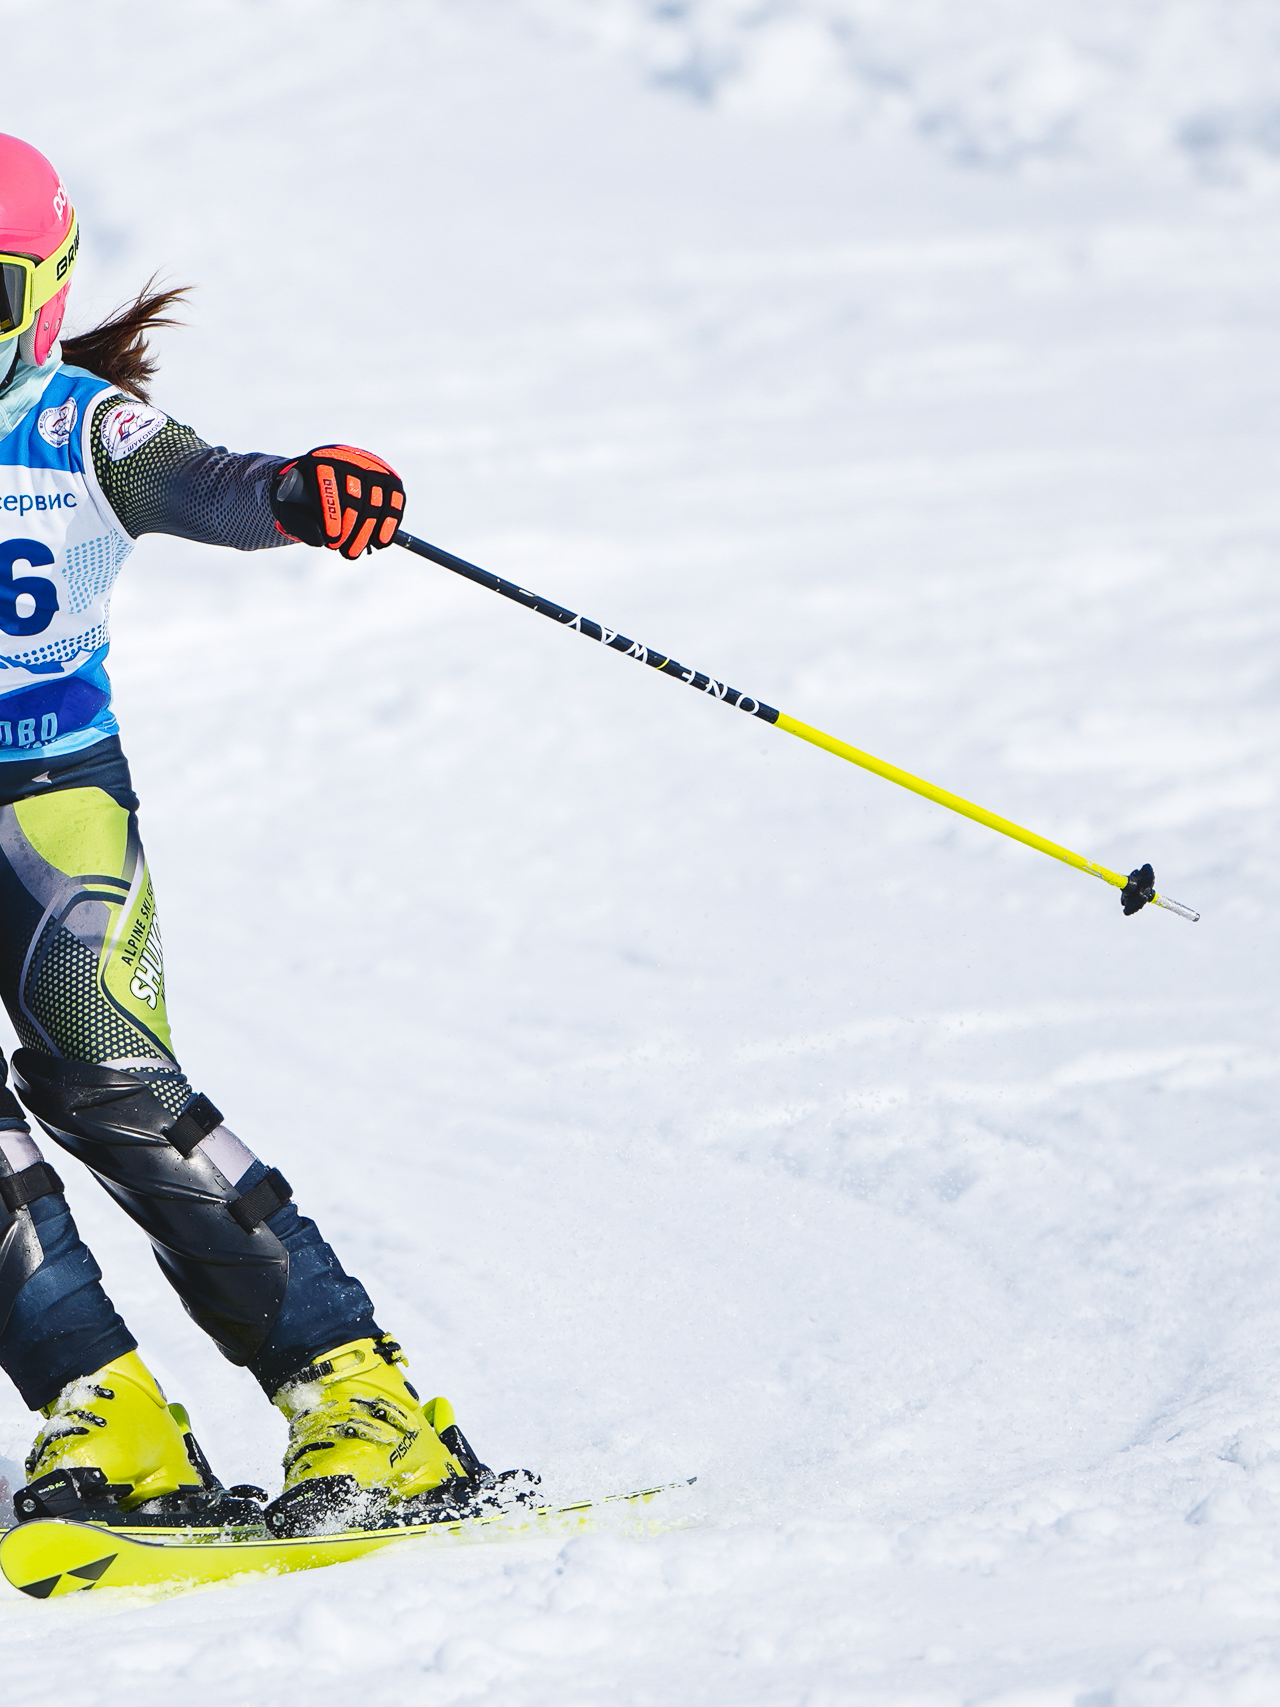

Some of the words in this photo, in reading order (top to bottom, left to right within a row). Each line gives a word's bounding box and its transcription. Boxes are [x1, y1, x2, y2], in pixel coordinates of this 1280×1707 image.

[323, 478, 338, 521] racing
[120, 918, 146, 967] ALPINE
[140, 897, 152, 920] SKI
